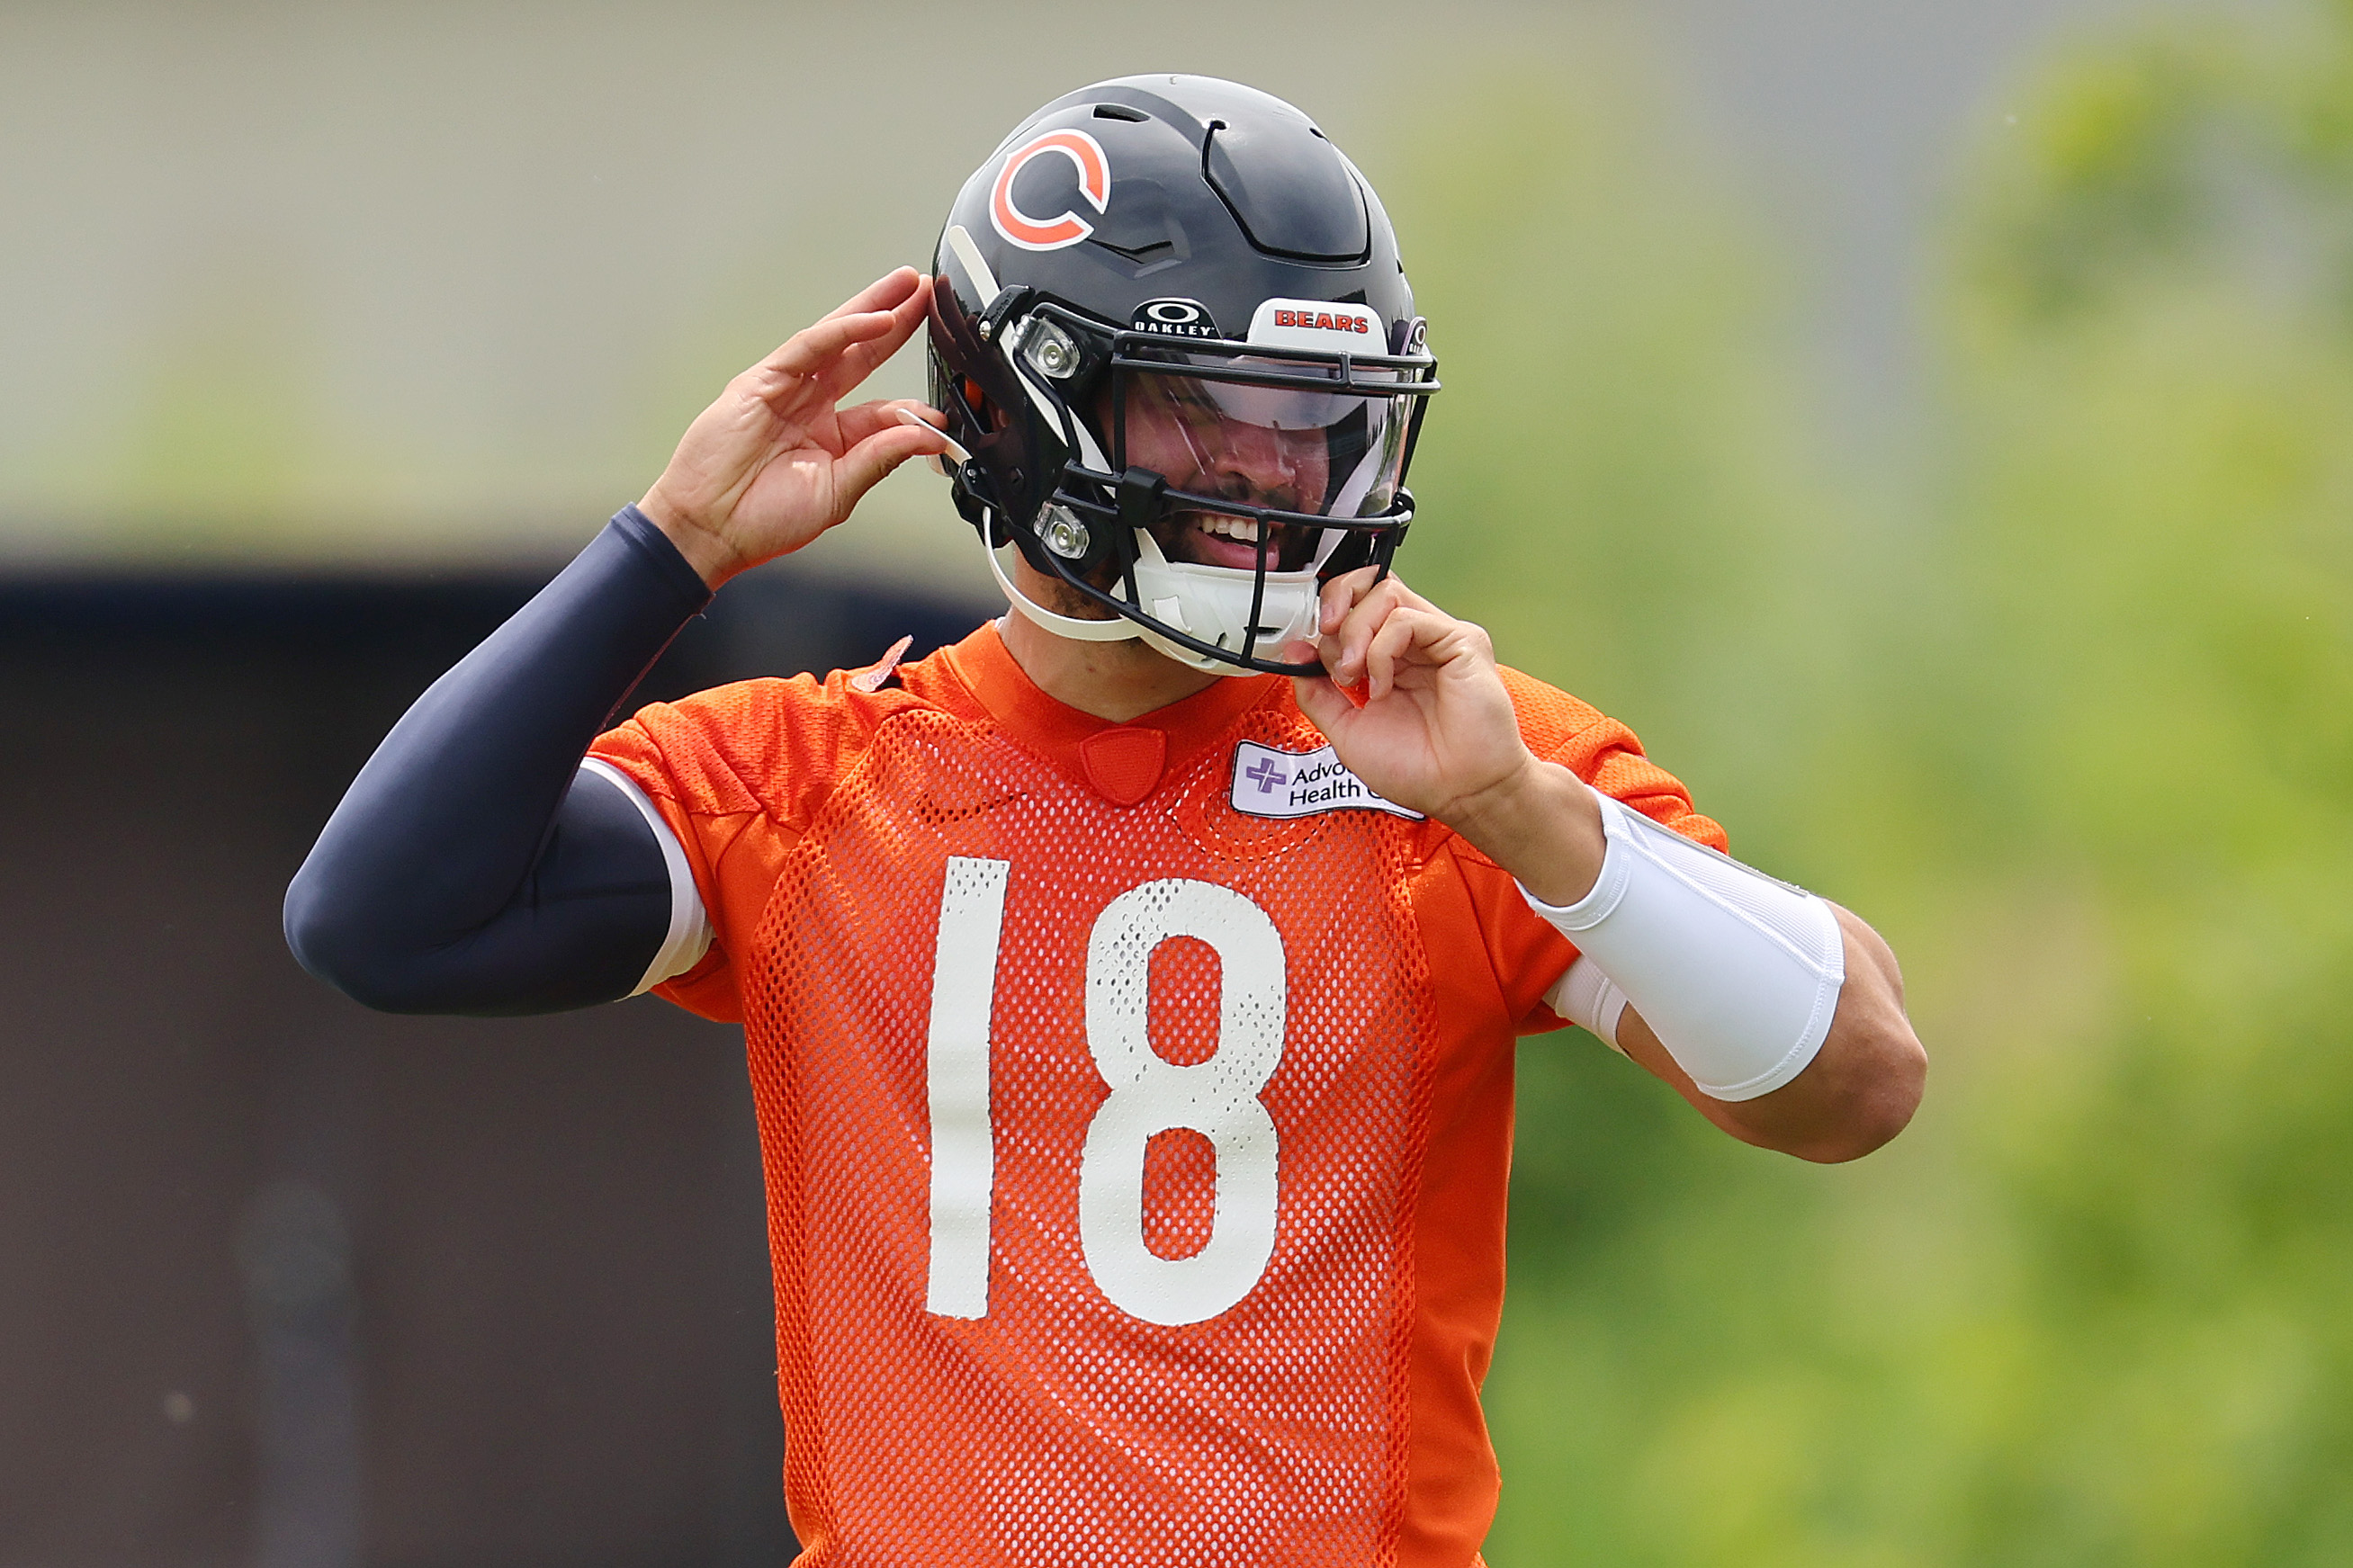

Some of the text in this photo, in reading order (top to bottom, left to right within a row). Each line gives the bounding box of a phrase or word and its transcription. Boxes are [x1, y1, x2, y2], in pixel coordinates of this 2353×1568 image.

[989, 128, 1111, 251] C
[1135, 321, 1211, 336] OAKLEY
[1274, 309, 1369, 334] BEARS
[1292, 762, 1352, 786] Advo
[1289, 778, 1361, 806] Health
[927, 856, 1287, 1326] 18
